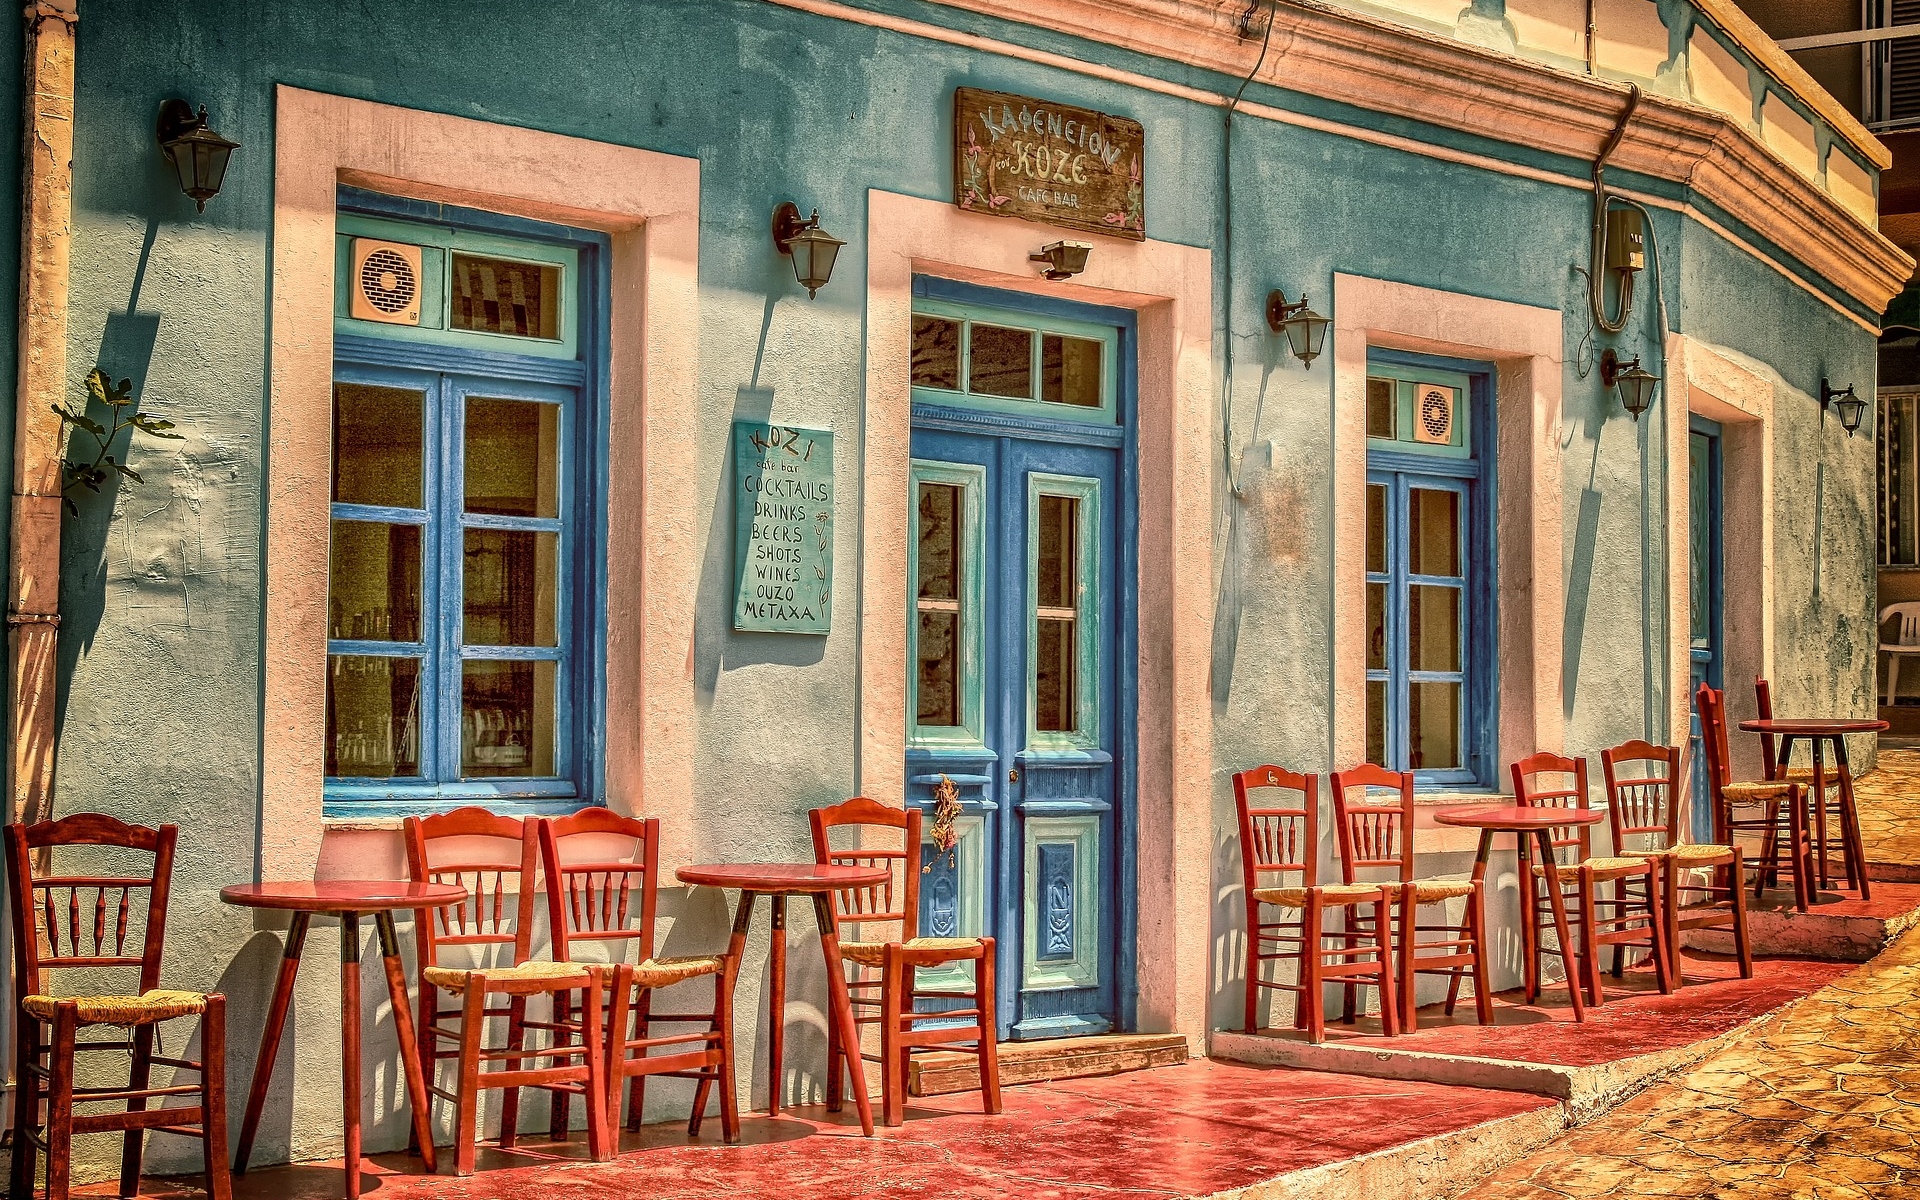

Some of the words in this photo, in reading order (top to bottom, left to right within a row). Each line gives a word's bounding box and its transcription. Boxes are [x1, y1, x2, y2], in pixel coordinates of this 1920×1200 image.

[1054, 190, 1080, 209] BAR
[749, 426, 815, 462] KOZI
[781, 461, 799, 473] bar
[744, 475, 829, 502] COCKTAILS
[754, 500, 806, 521] DRINKS
[751, 522, 803, 543] BEERS
[756, 544, 802, 564] SHOTS
[755, 564, 801, 583] WINES
[756, 584, 794, 602] OUZO
[744, 602, 815, 622] METAXA
